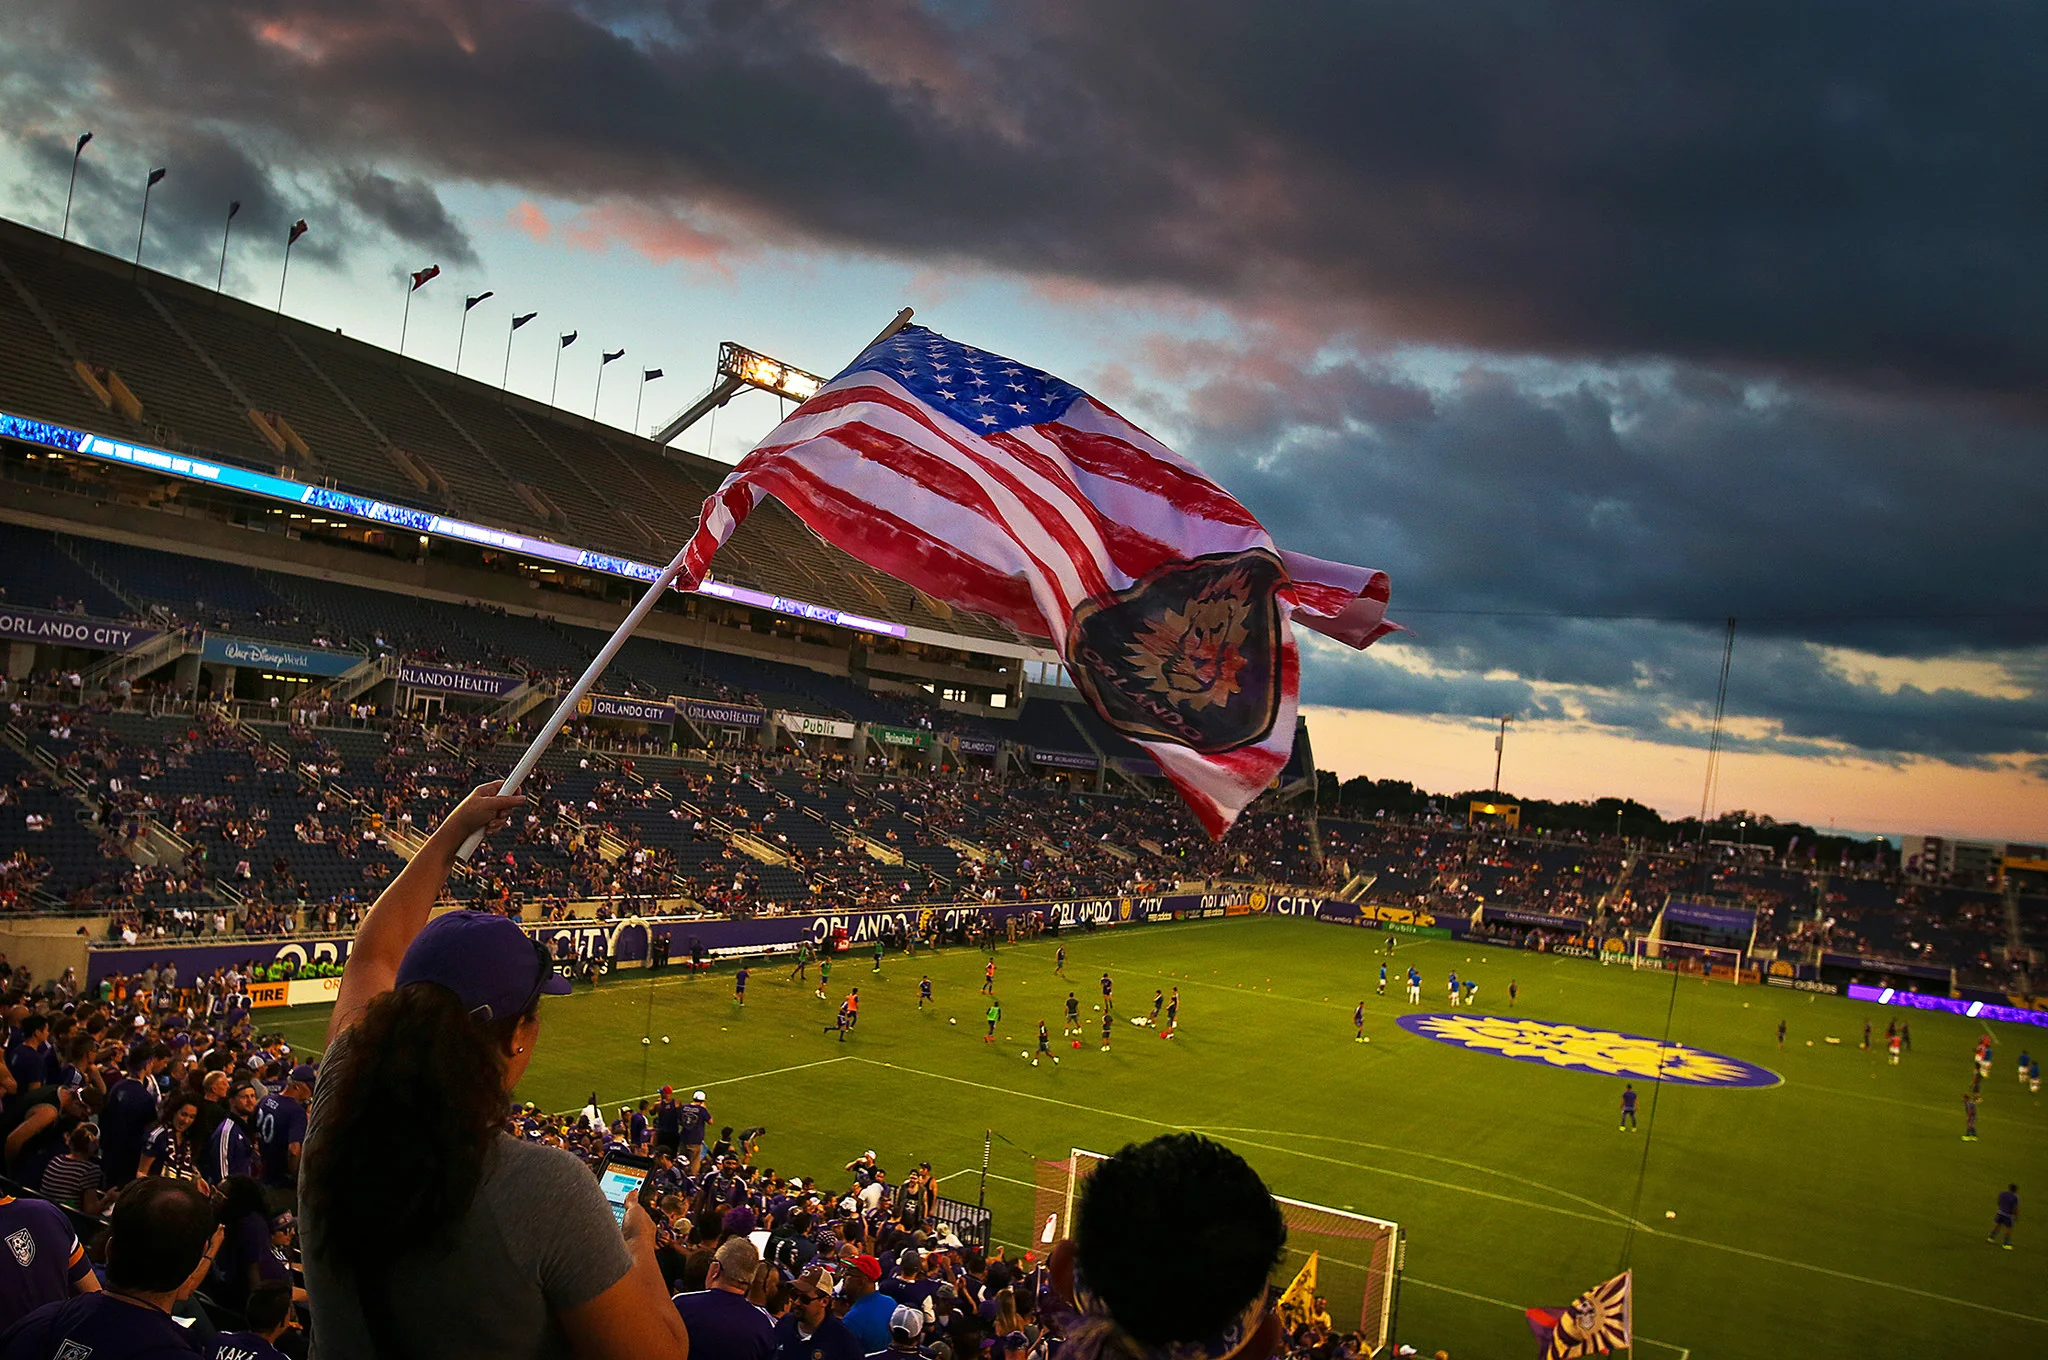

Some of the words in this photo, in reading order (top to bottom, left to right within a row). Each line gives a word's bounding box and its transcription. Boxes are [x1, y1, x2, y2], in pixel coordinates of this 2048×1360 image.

[0, 615, 89, 641] ORLANDO
[94, 628, 131, 646] CITY
[399, 669, 453, 687] RLANDO
[453, 675, 500, 693] HEALTH
[597, 702, 643, 717] ORLANDO
[644, 707, 665, 720] CITY
[688, 706, 730, 721] ORLANDO
[729, 711, 761, 725] HEALTH
[802, 718, 835, 735] Publix
[885, 731, 913, 746] Heineken
[1277, 896, 1323, 916] CITY
[1362, 919, 1378, 928] CITY
[251, 988, 284, 1002] TIRE
[1794, 980, 1838, 995] adidas
